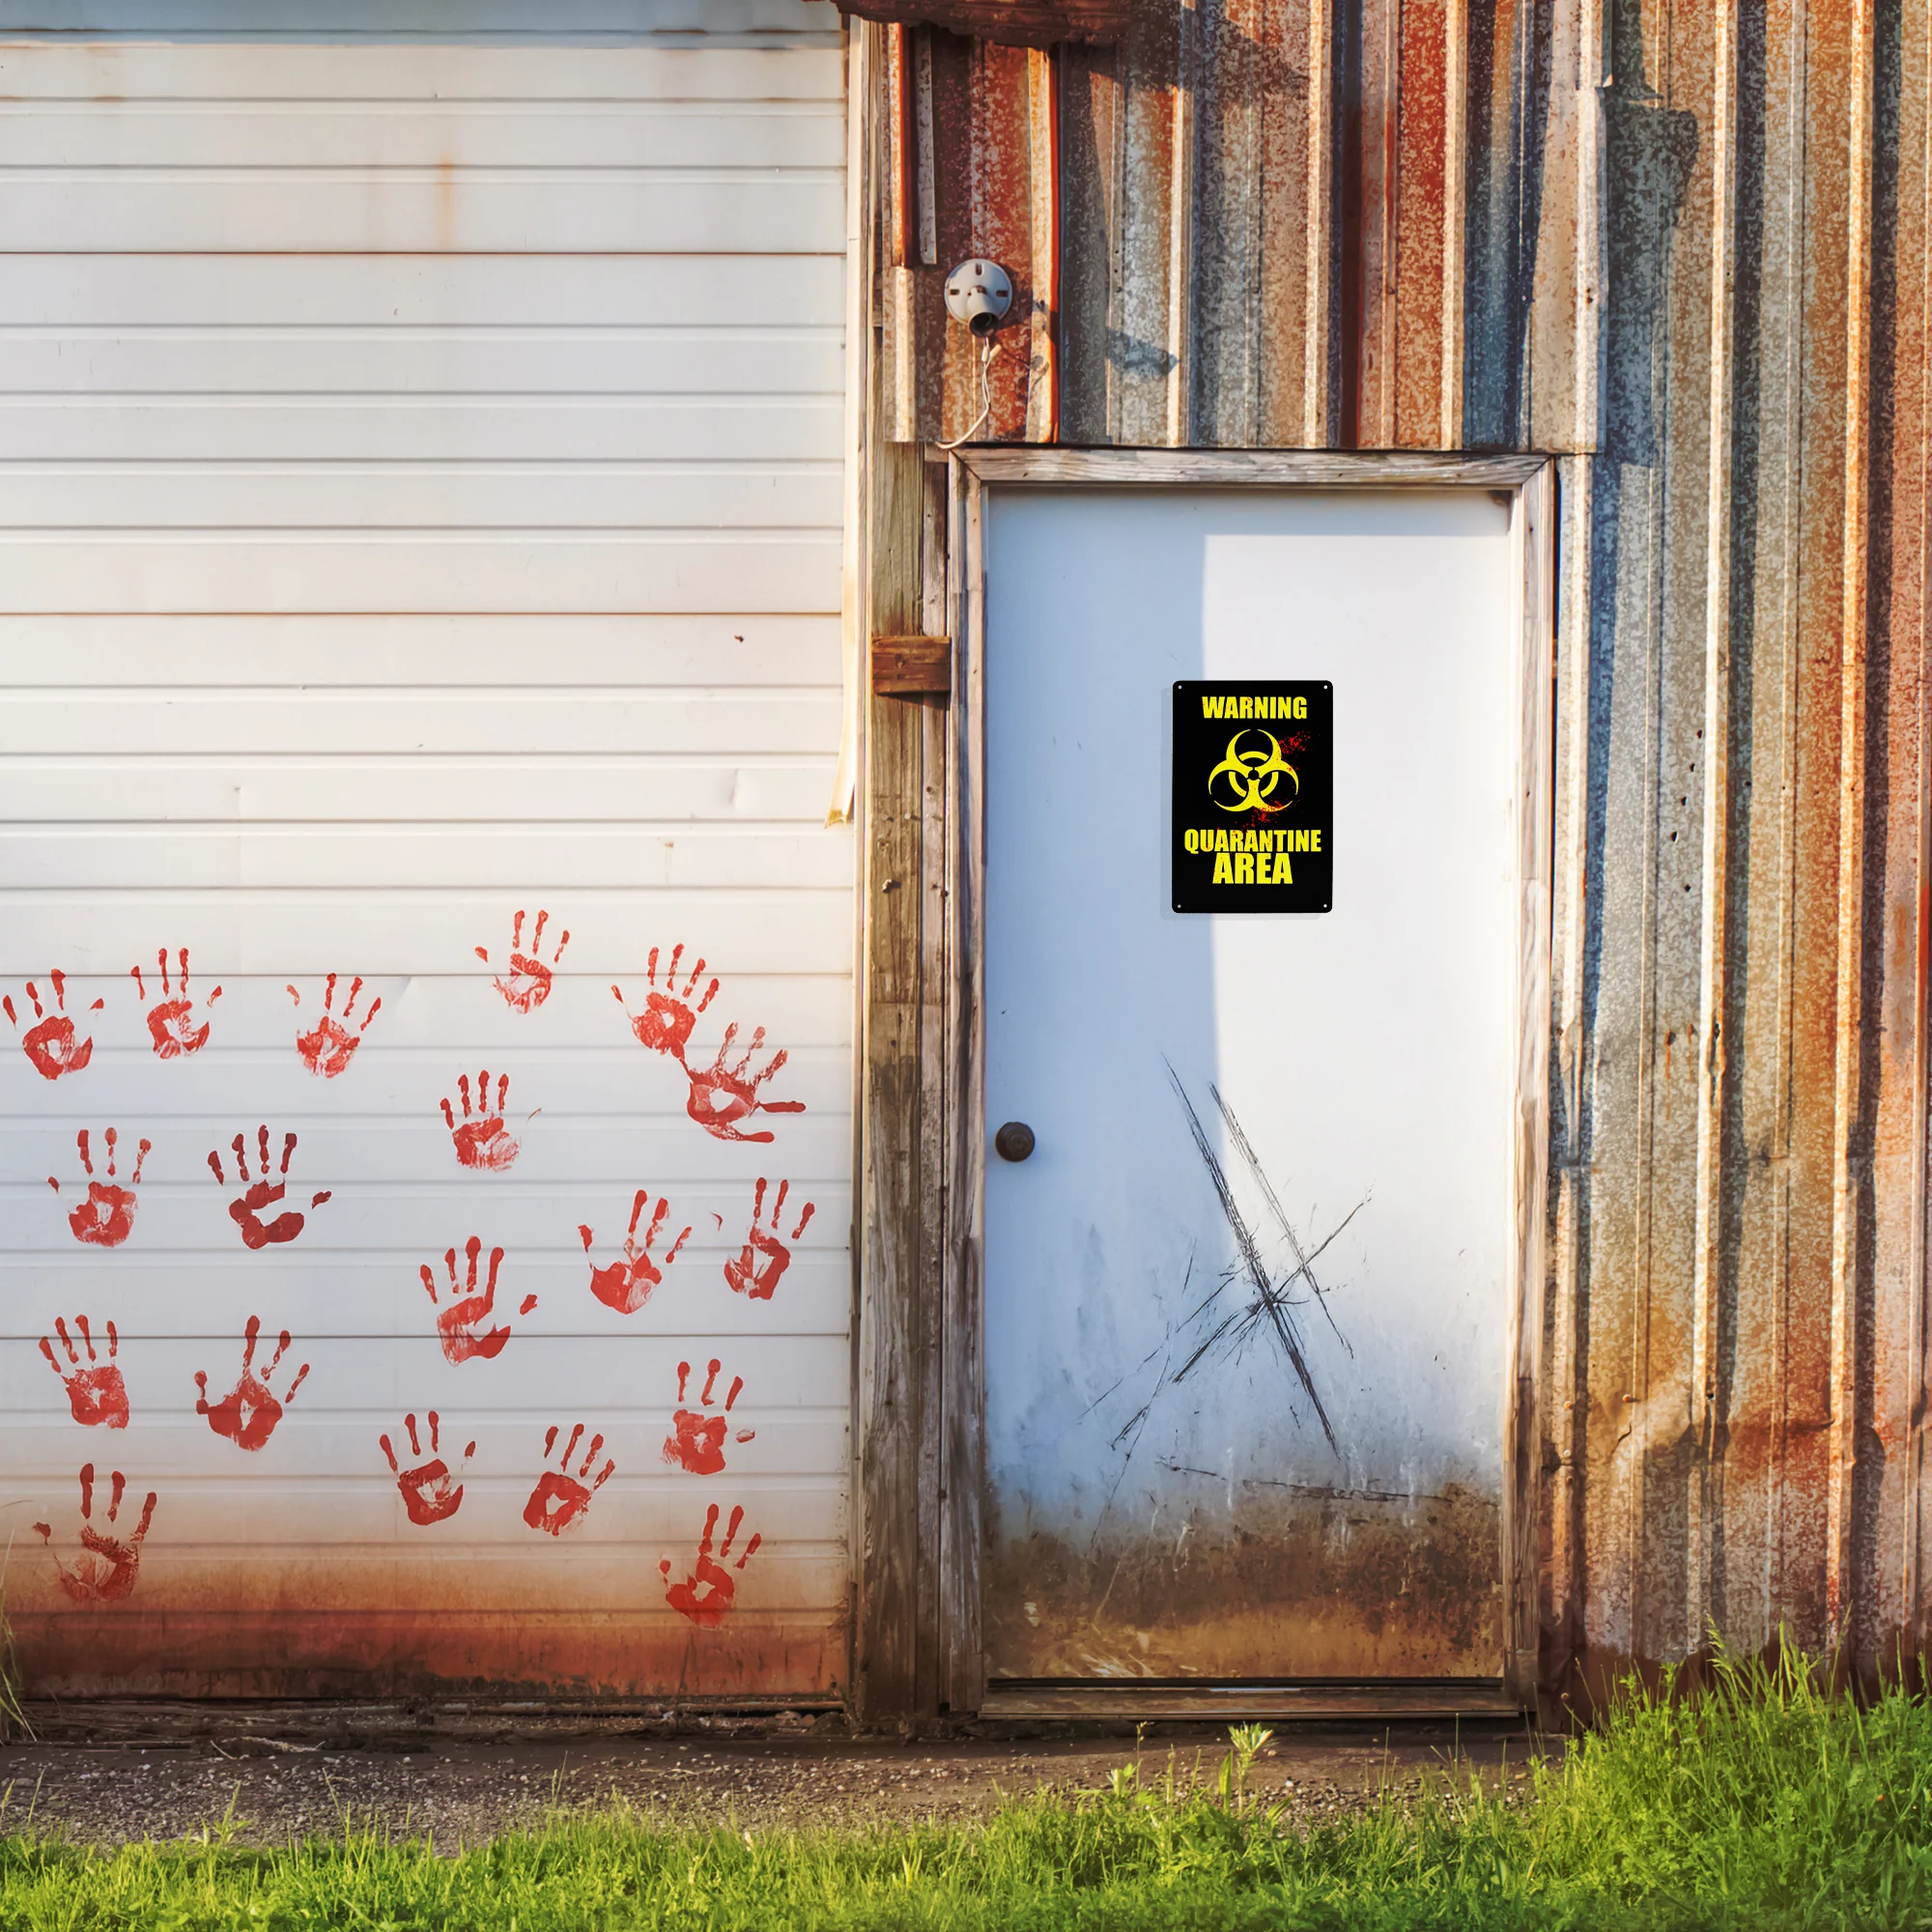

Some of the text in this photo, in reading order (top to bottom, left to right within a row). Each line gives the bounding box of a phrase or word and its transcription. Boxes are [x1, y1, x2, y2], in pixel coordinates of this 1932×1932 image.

[1202, 696, 1307, 720] WARNING
[1184, 829, 1321, 854] QUARANTINE
[1212, 852, 1293, 884] AREA
